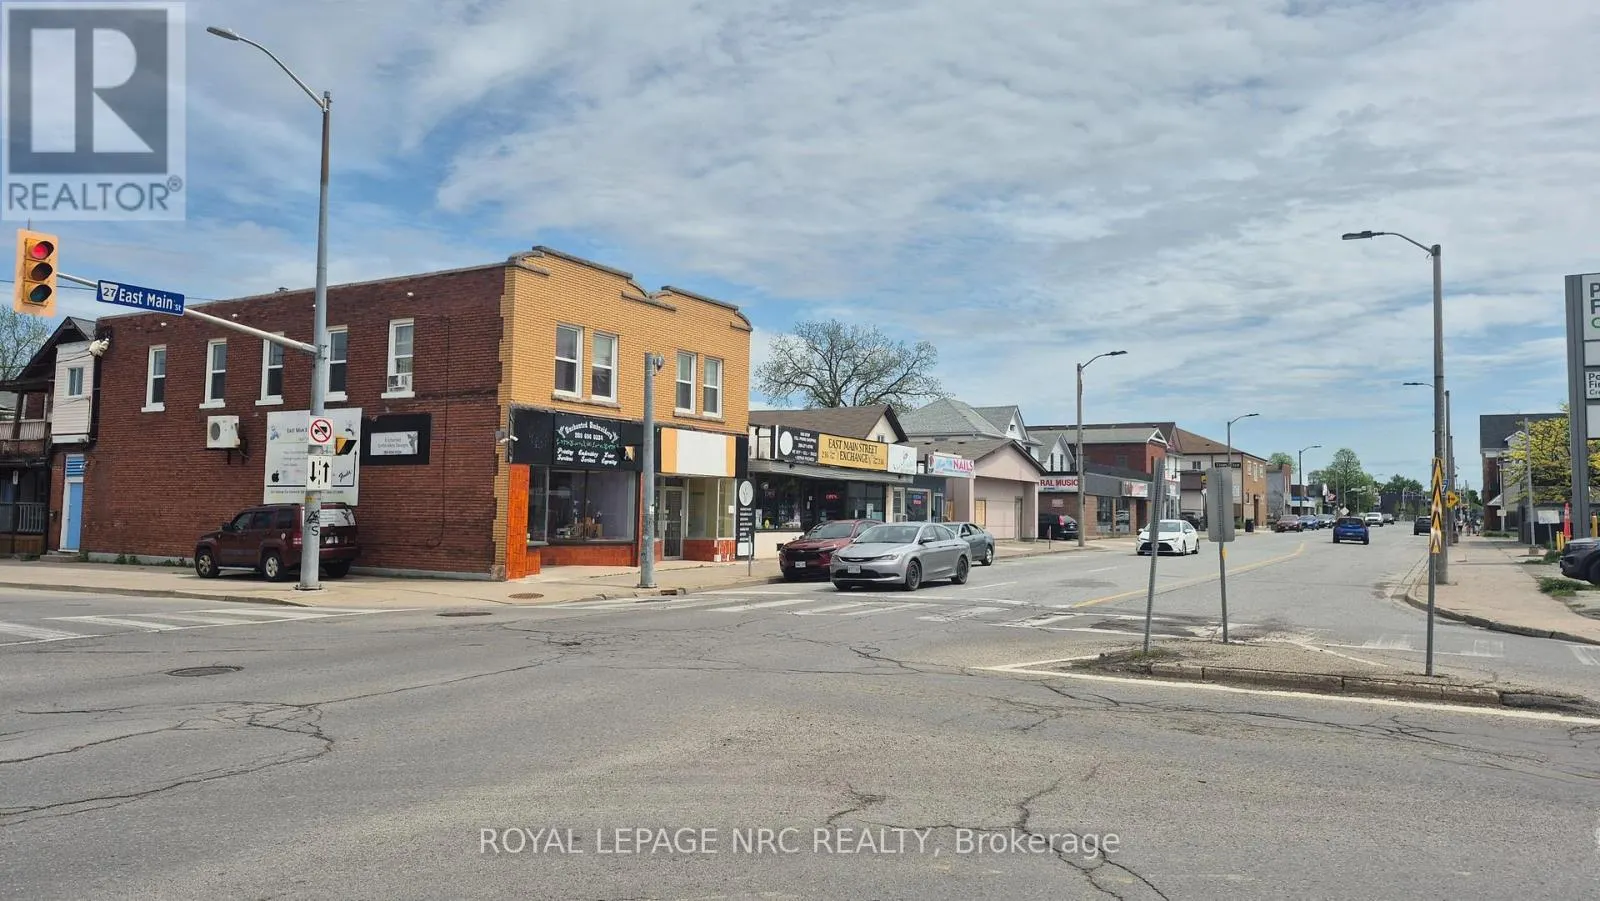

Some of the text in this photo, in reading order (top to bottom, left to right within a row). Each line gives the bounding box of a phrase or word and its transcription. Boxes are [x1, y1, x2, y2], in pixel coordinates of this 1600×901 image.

[103, 287, 117, 298] 27
[119, 288, 143, 305] East
[147, 293, 173, 310] Main
[828, 439, 842, 449] EAST
[843, 441, 859, 452] MAIN
[859, 443, 878, 454] STREET
[953, 459, 974, 472] NAILS
[1056, 479, 1079, 487] MUSIC
